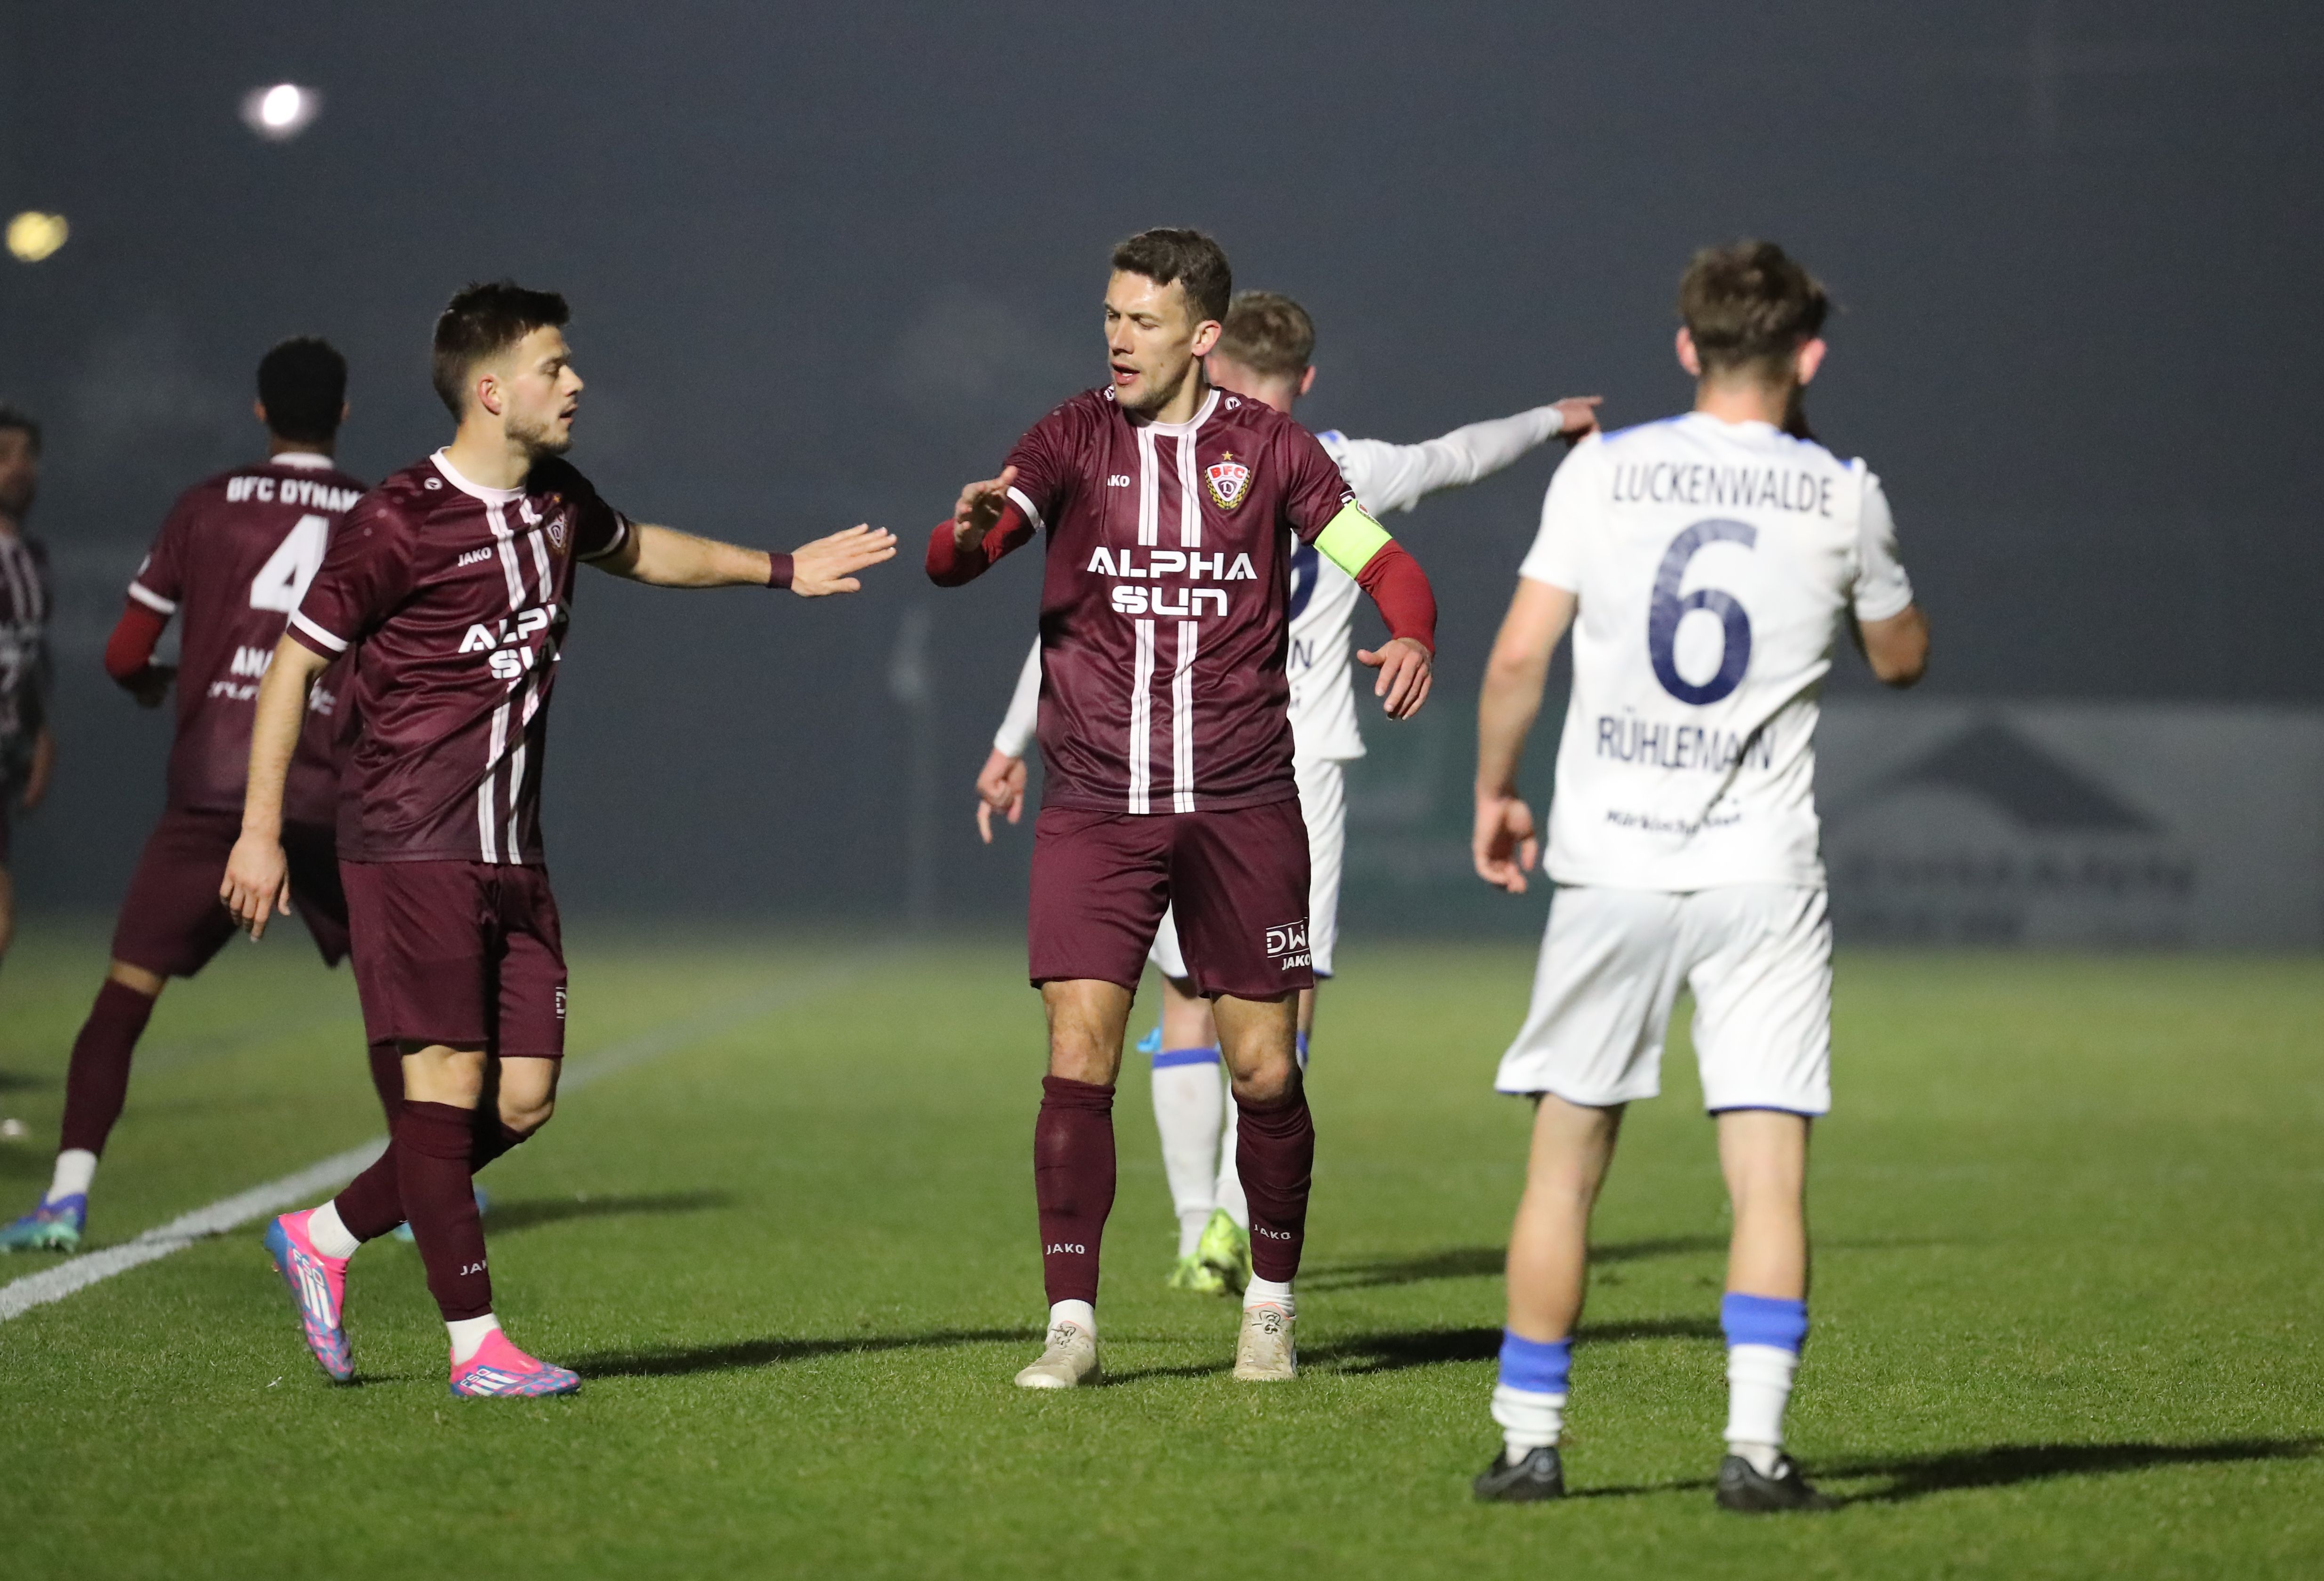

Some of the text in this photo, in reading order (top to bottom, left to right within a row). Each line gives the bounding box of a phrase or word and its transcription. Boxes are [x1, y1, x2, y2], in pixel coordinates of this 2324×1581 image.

[1107, 474, 1130, 487] KO
[1210, 466, 1245, 479] BFC
[227, 476, 365, 513] BFC DYNAM
[1613, 462, 1833, 518] LUCKENWALDE
[249, 514, 329, 613] 4
[458, 547, 492, 567] JAKO
[1087, 546, 1258, 580] ALPHA
[1111, 585, 1228, 616] SUN
[1648, 517, 1759, 705] 6
[1282, 953, 1311, 971] JAKO
[1254, 1224, 1291, 1240] JAKO
[1046, 1243, 1085, 1255] JAKO
[460, 1259, 486, 1276] JA
